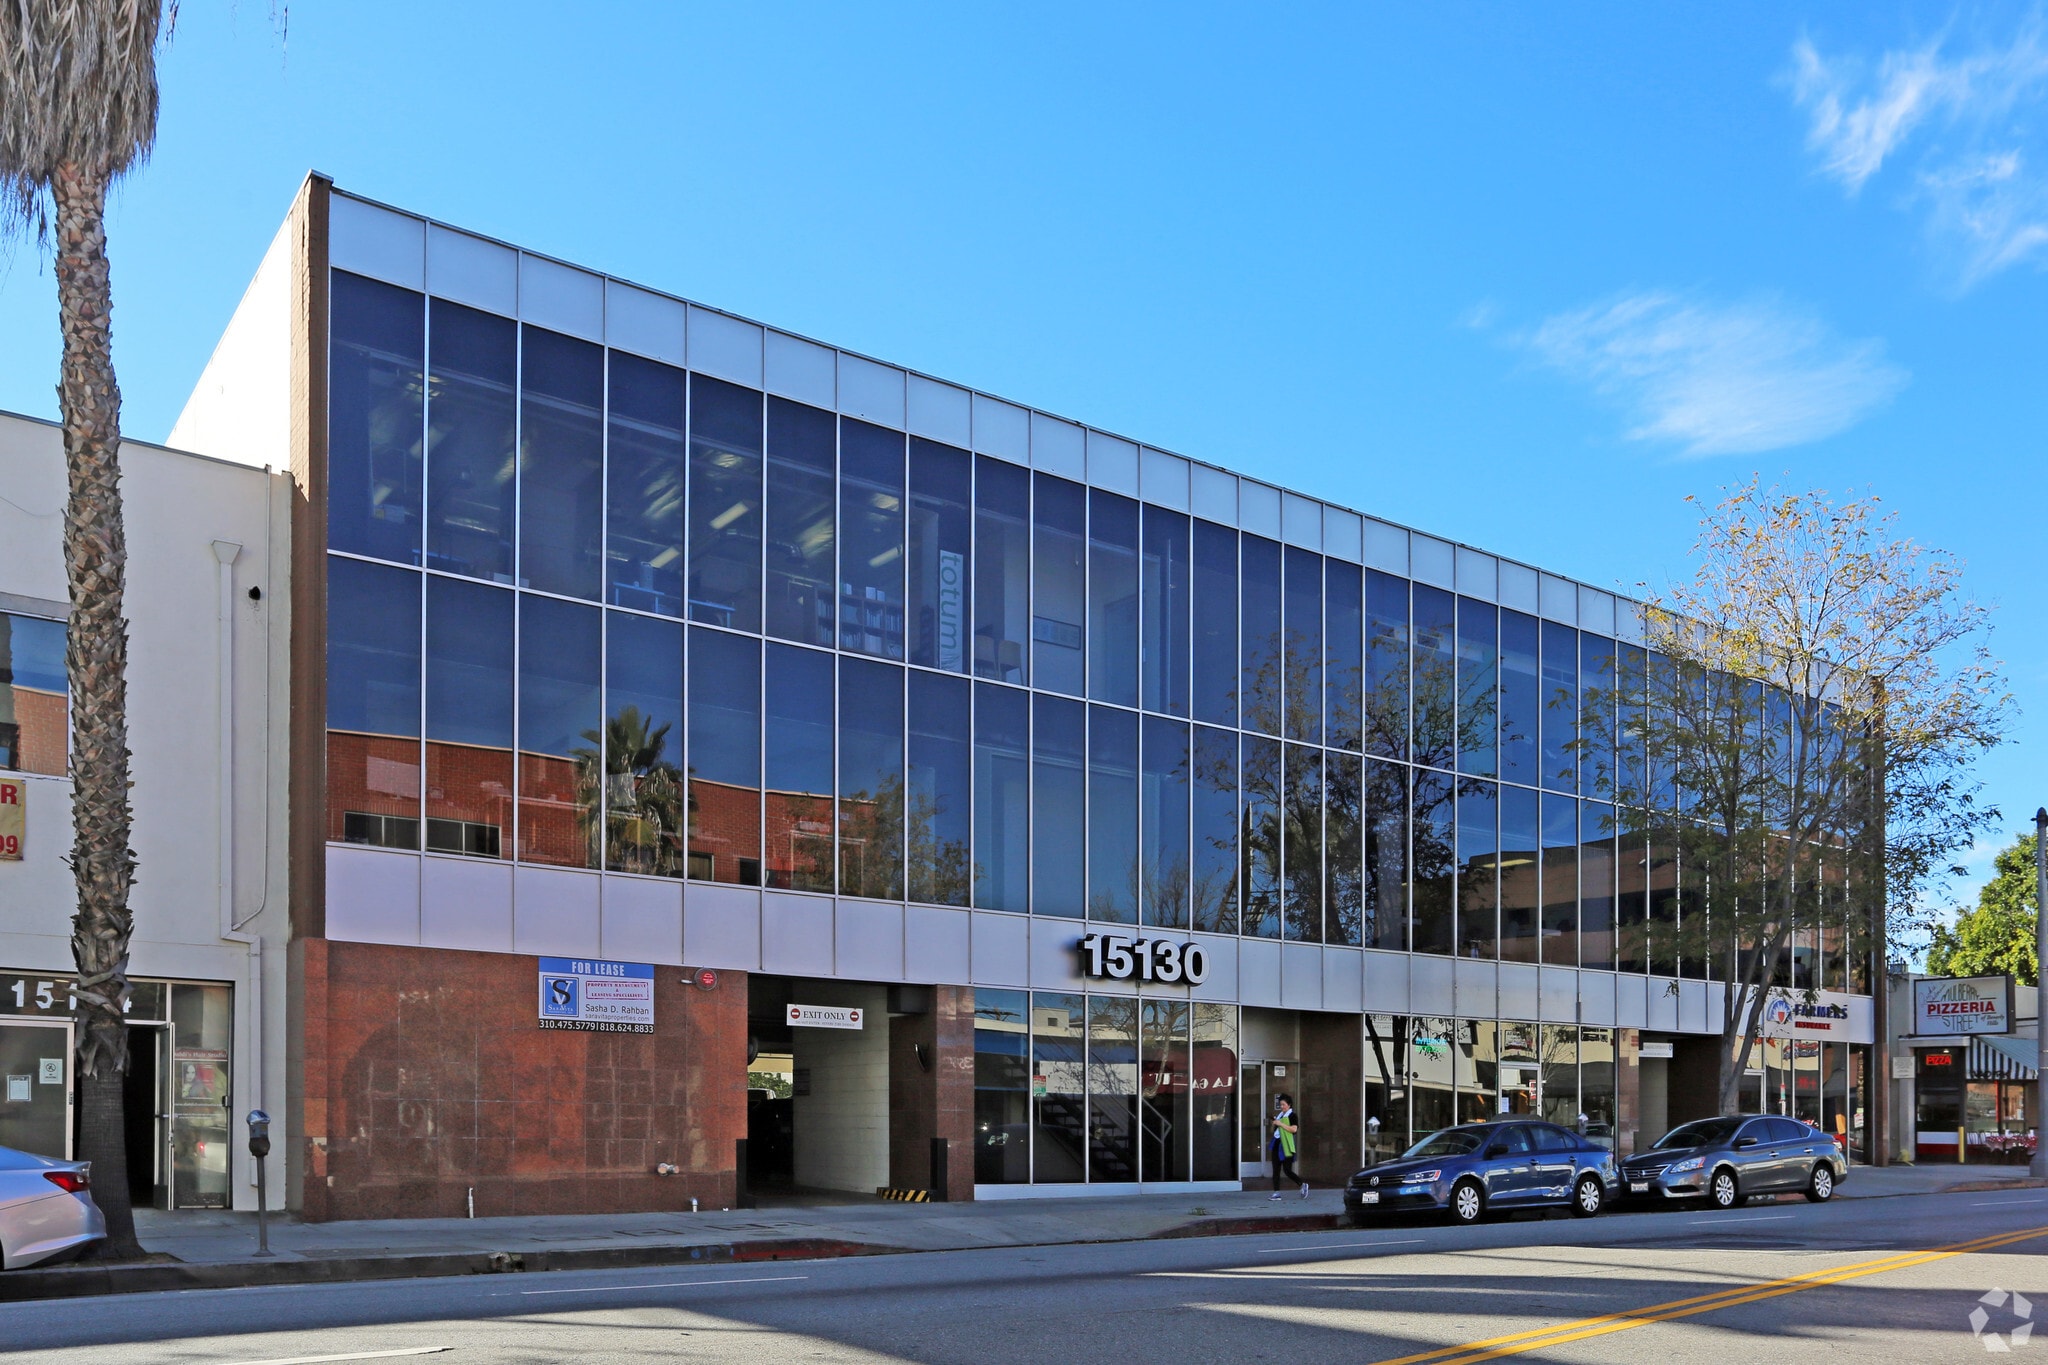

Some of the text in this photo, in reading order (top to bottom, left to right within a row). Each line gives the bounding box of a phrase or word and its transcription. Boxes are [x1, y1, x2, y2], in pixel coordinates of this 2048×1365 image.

[941, 555, 960, 650] totum
[1083, 934, 1211, 986] 15130
[571, 961, 625, 976] FOR LEASE
[1940, 983, 1980, 1002] MULBERRY
[585, 1004, 649, 1015] Sasha D. Rahban
[803, 1010, 846, 1020] EXIT ONLY
[1927, 1001, 1995, 1015] PIZZERIA
[585, 1013, 650, 1022] saravitaproperties.com
[1941, 1014, 1980, 1032] STREET
[1926, 1055, 1951, 1065] PIZZA
